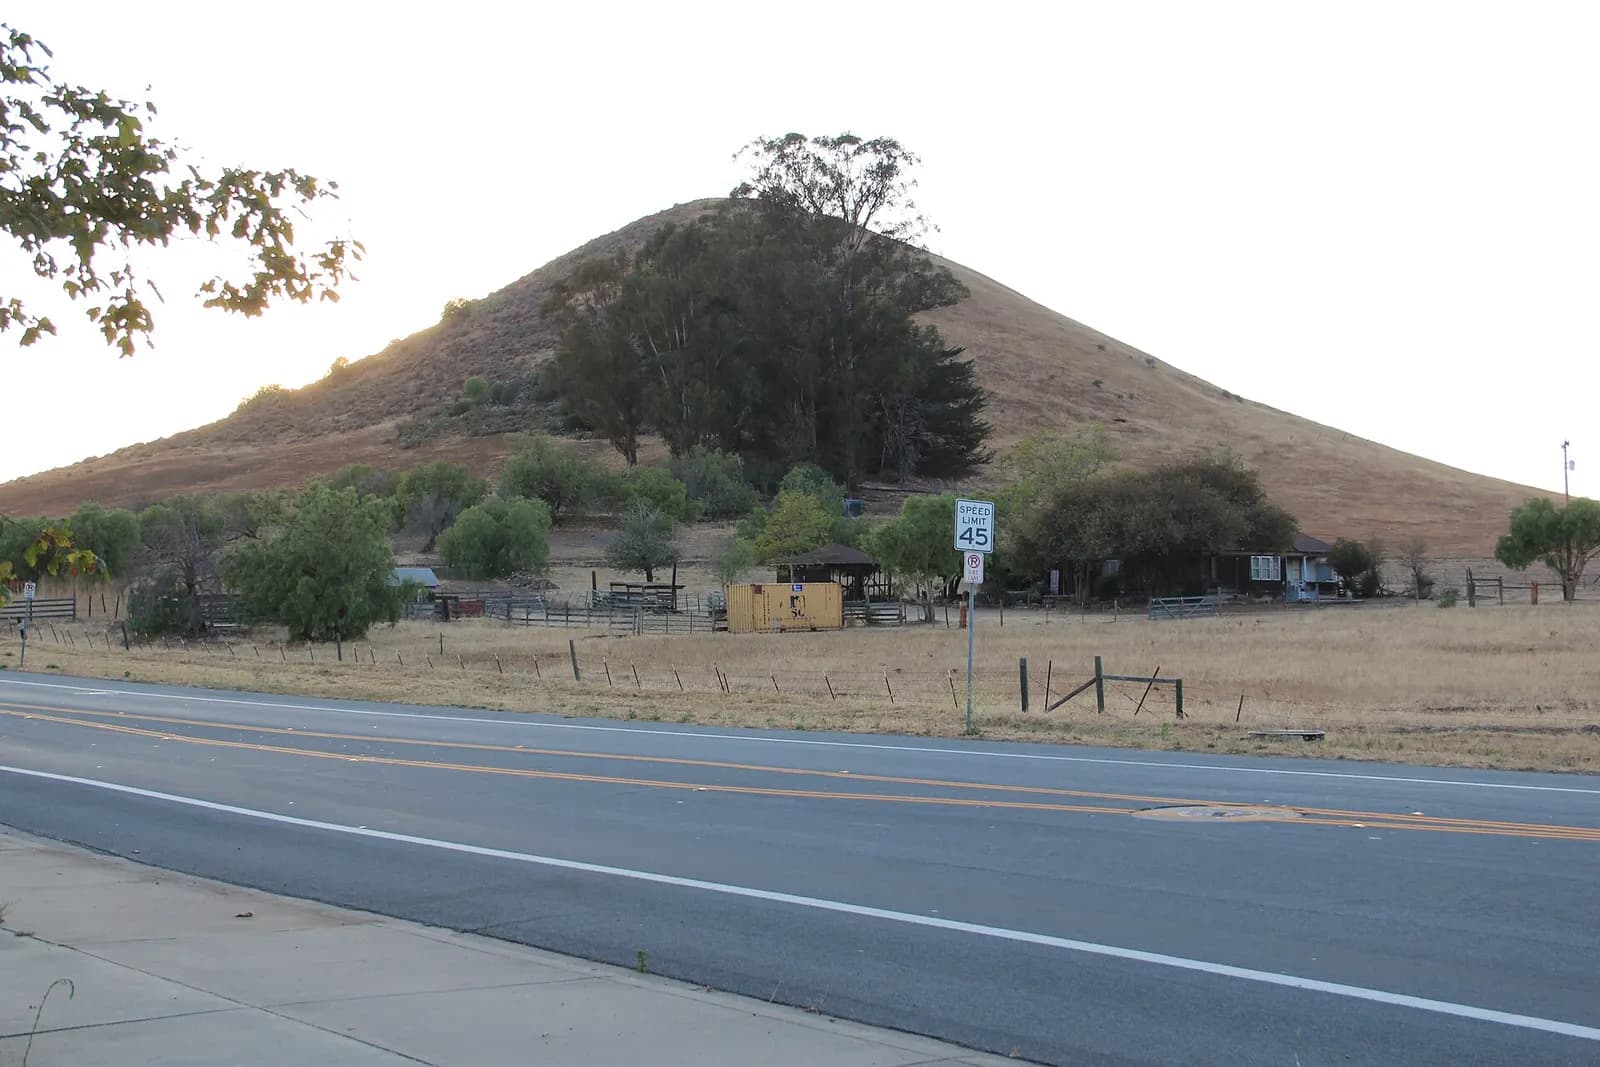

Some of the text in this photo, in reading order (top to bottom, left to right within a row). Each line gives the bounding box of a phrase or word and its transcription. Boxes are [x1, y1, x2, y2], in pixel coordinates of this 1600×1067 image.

[960, 505, 990, 516] SPEED
[963, 517, 986, 525] LIMIT
[960, 527, 988, 546] 45
